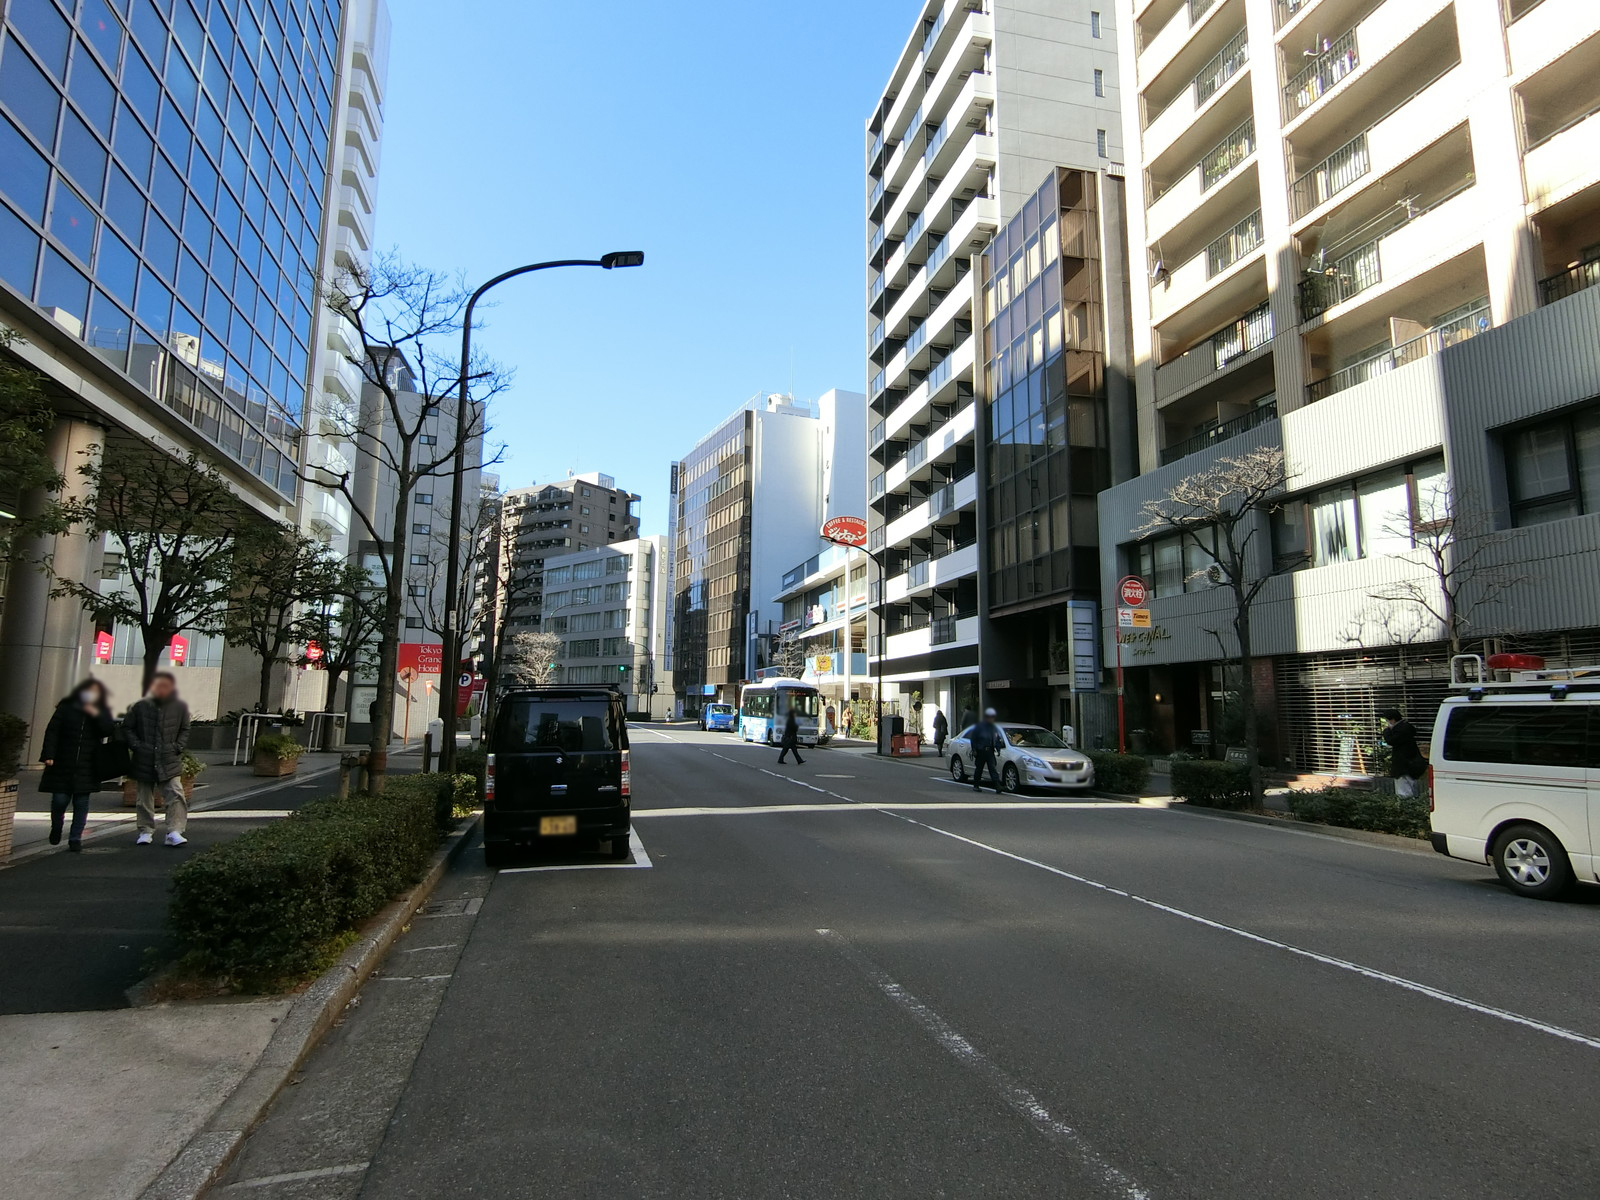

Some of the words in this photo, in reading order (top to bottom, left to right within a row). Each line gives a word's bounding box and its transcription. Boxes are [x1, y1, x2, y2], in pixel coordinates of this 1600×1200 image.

[1124, 588, 1143, 598] 消火栓
[419, 645, 442, 654] Tokyo
[418, 664, 439, 673] Hotel
[461, 675, 469, 685] P
